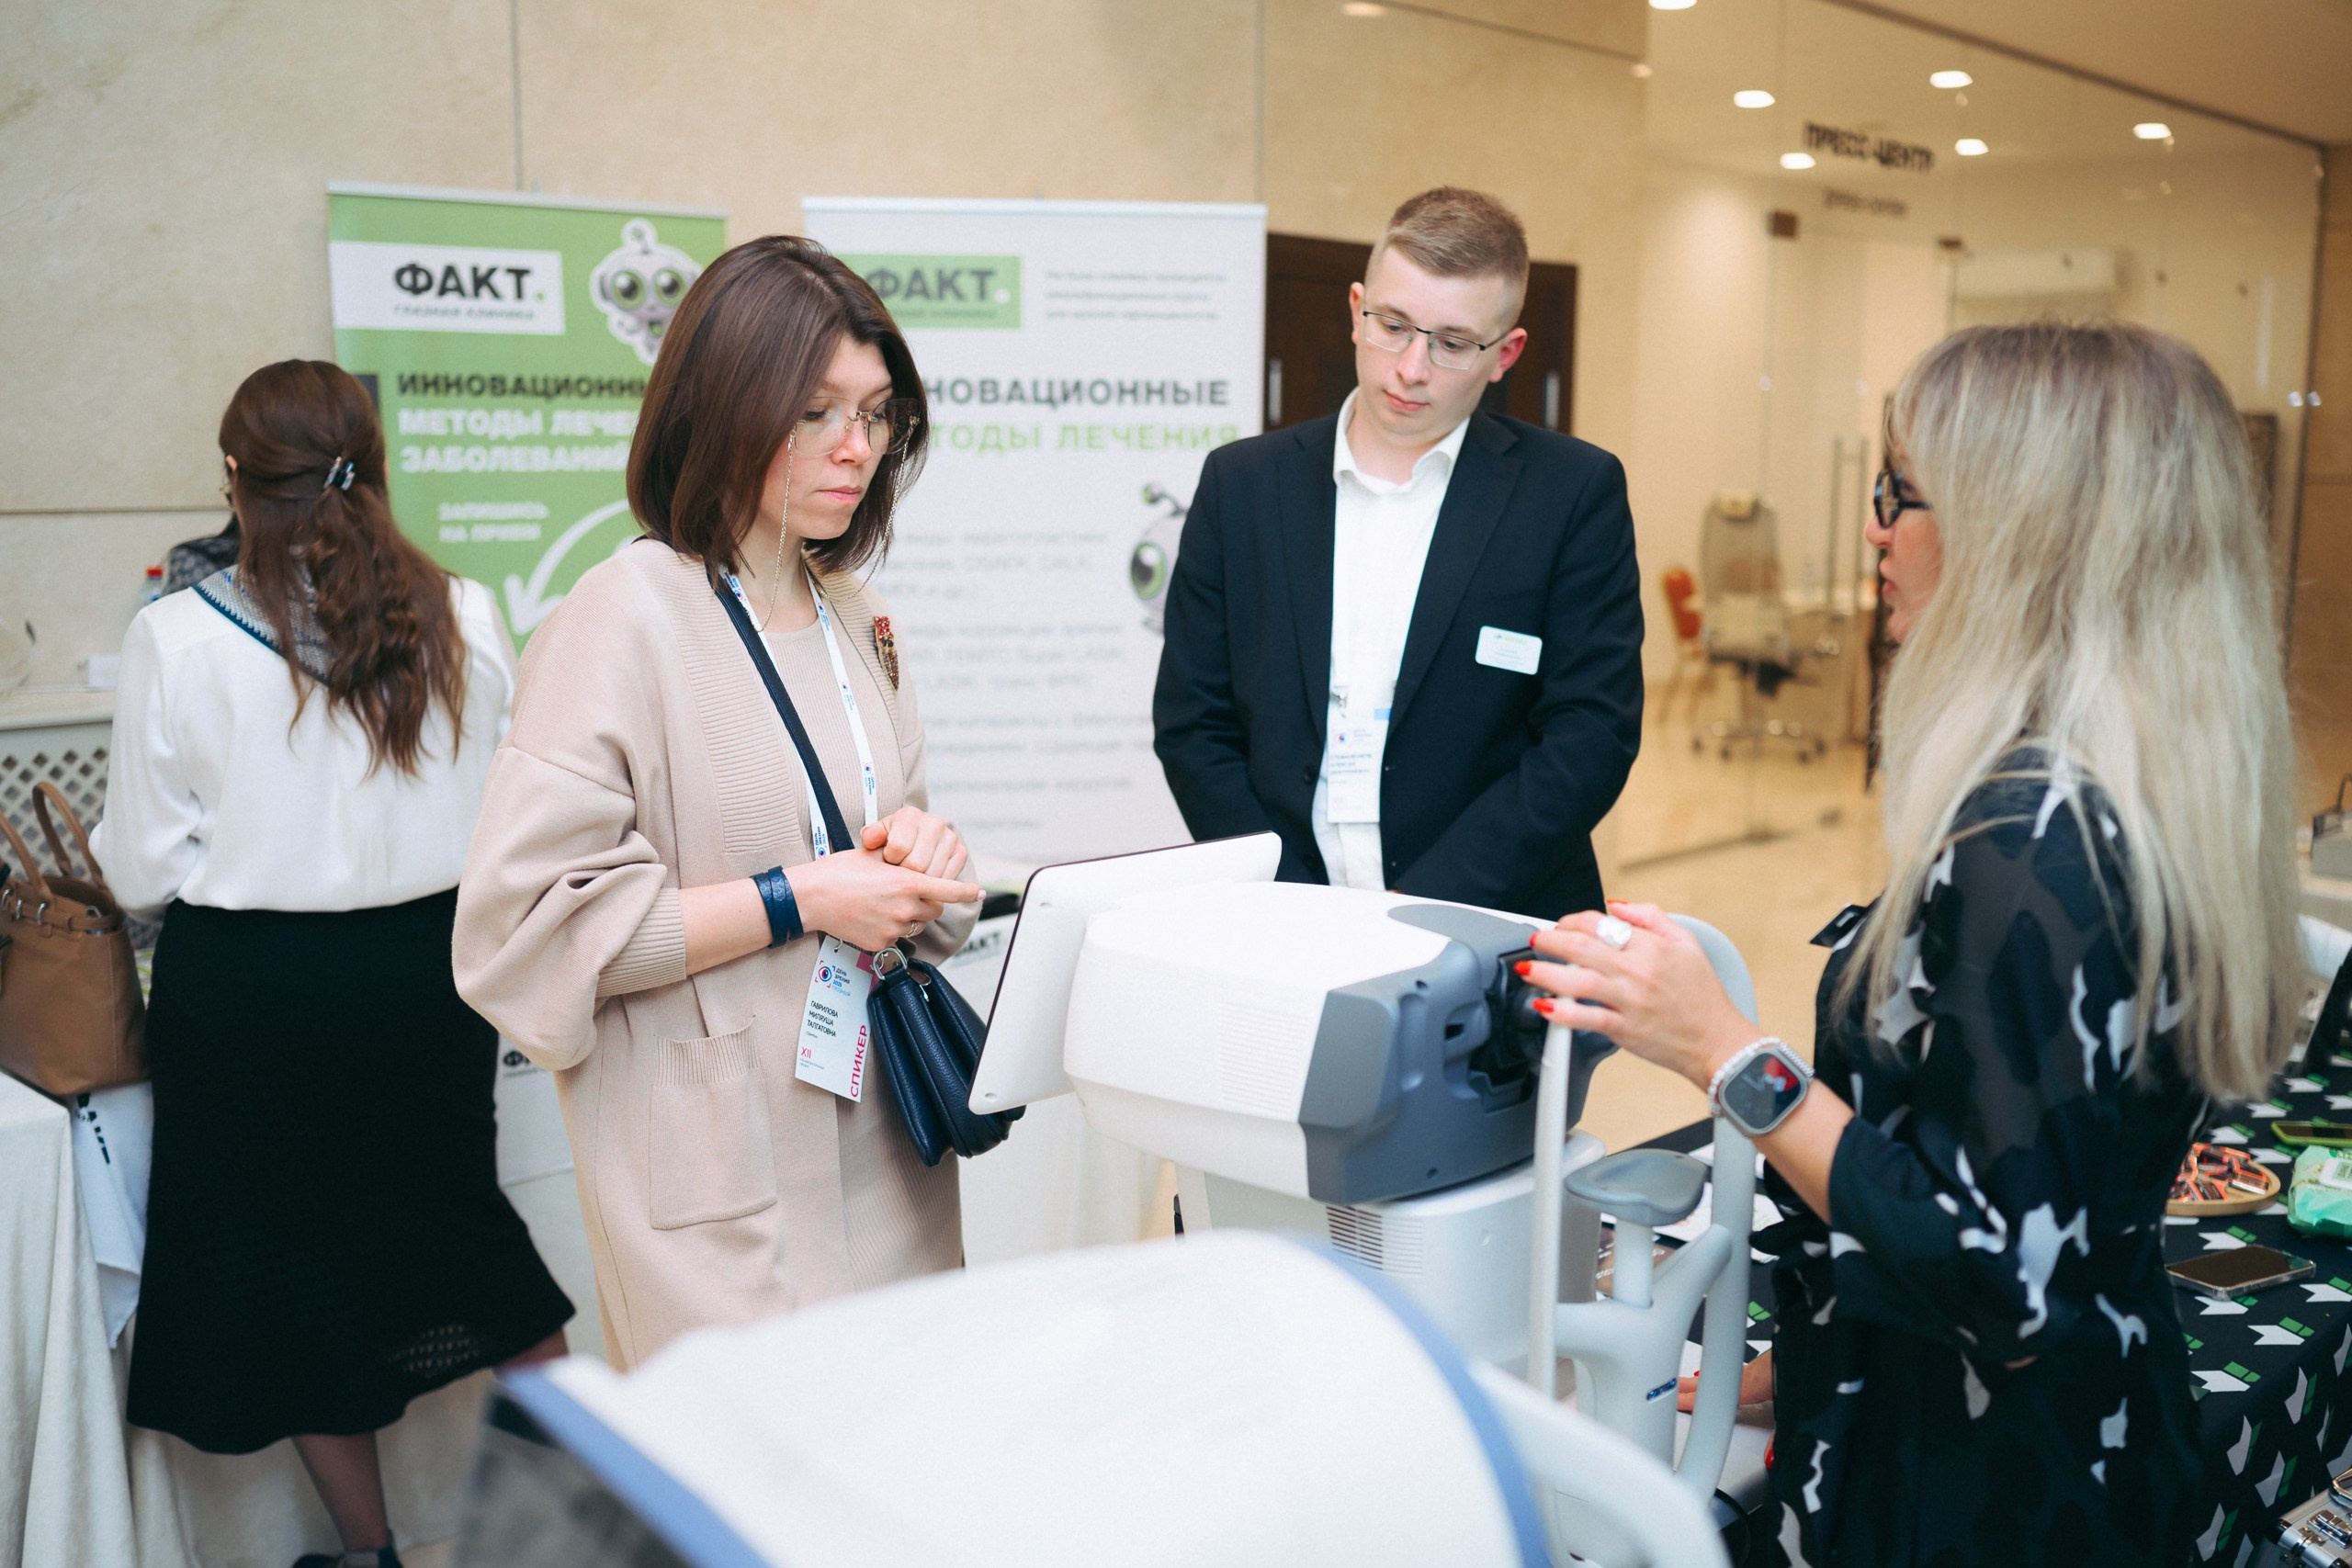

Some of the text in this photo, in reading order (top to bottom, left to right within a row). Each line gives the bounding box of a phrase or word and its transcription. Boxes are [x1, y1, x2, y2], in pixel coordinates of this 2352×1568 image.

[394, 263, 544, 299] ФАКТ.
[399, 374, 647, 401] ИННОВАЦИОНН
[922, 378, 1230, 409] НОВАЦИОННЫЕ
[399, 409, 638, 439] МЕТОДЫ ЛЕЧЕ
[930, 423, 1040, 454] ТОДЫ
[834, 974, 851, 984] ЗРЕНИЯ
[836, 968, 847, 976] ДЕНЬ
[808, 1010, 834, 1026] МИЛЯУША
[810, 1000, 838, 1018] ГАВРИЛОВА
[807, 1020, 837, 1037] ТАЛГАТОВНА
[850, 1025, 867, 1098] СПИКЕР
